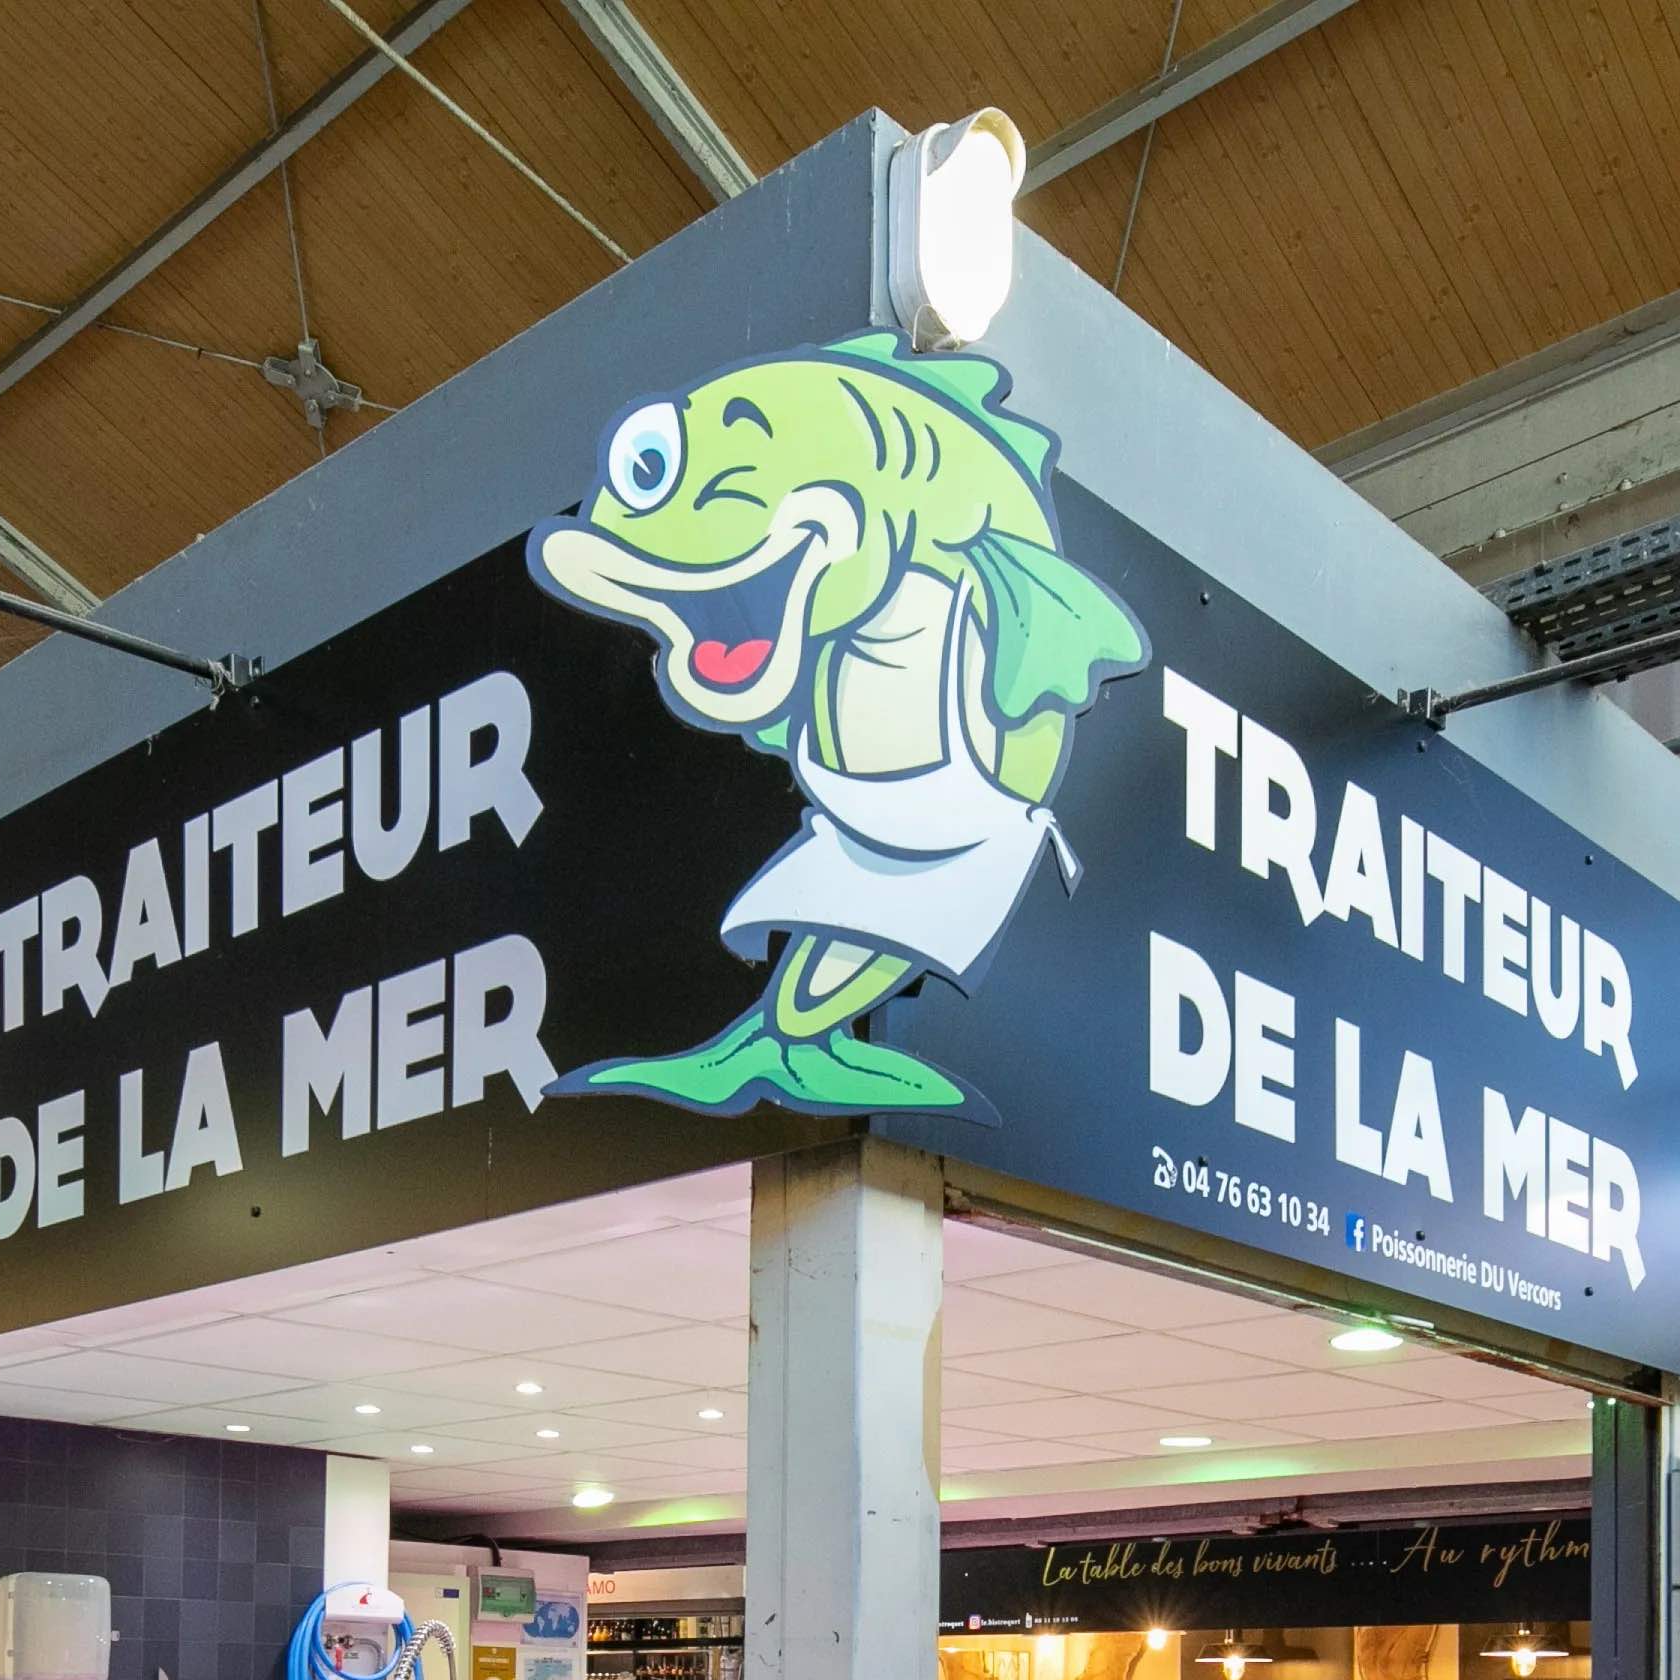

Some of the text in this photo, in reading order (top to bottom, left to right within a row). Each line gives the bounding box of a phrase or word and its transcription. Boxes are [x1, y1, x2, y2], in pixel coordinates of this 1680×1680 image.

[1163, 666, 1639, 1090] TRAITEUR
[119, 1041, 244, 1205] LA
[282, 933, 559, 1158] MER
[1150, 930, 1646, 1292] DE LA MER
[1183, 1160, 1330, 1236] 04 76 63 10 34
[1372, 1225, 1561, 1311] Poissonnerie DU Vercors
[1043, 1547, 1077, 1586] La
[1080, 1542, 1145, 1585] table
[1151, 1540, 1185, 1579] des
[1192, 1538, 1243, 1577] bons
[1252, 1539, 1338, 1575] vivants
[1390, 1524, 1464, 1573] Au
[1481, 1520, 1590, 1588] rythm
